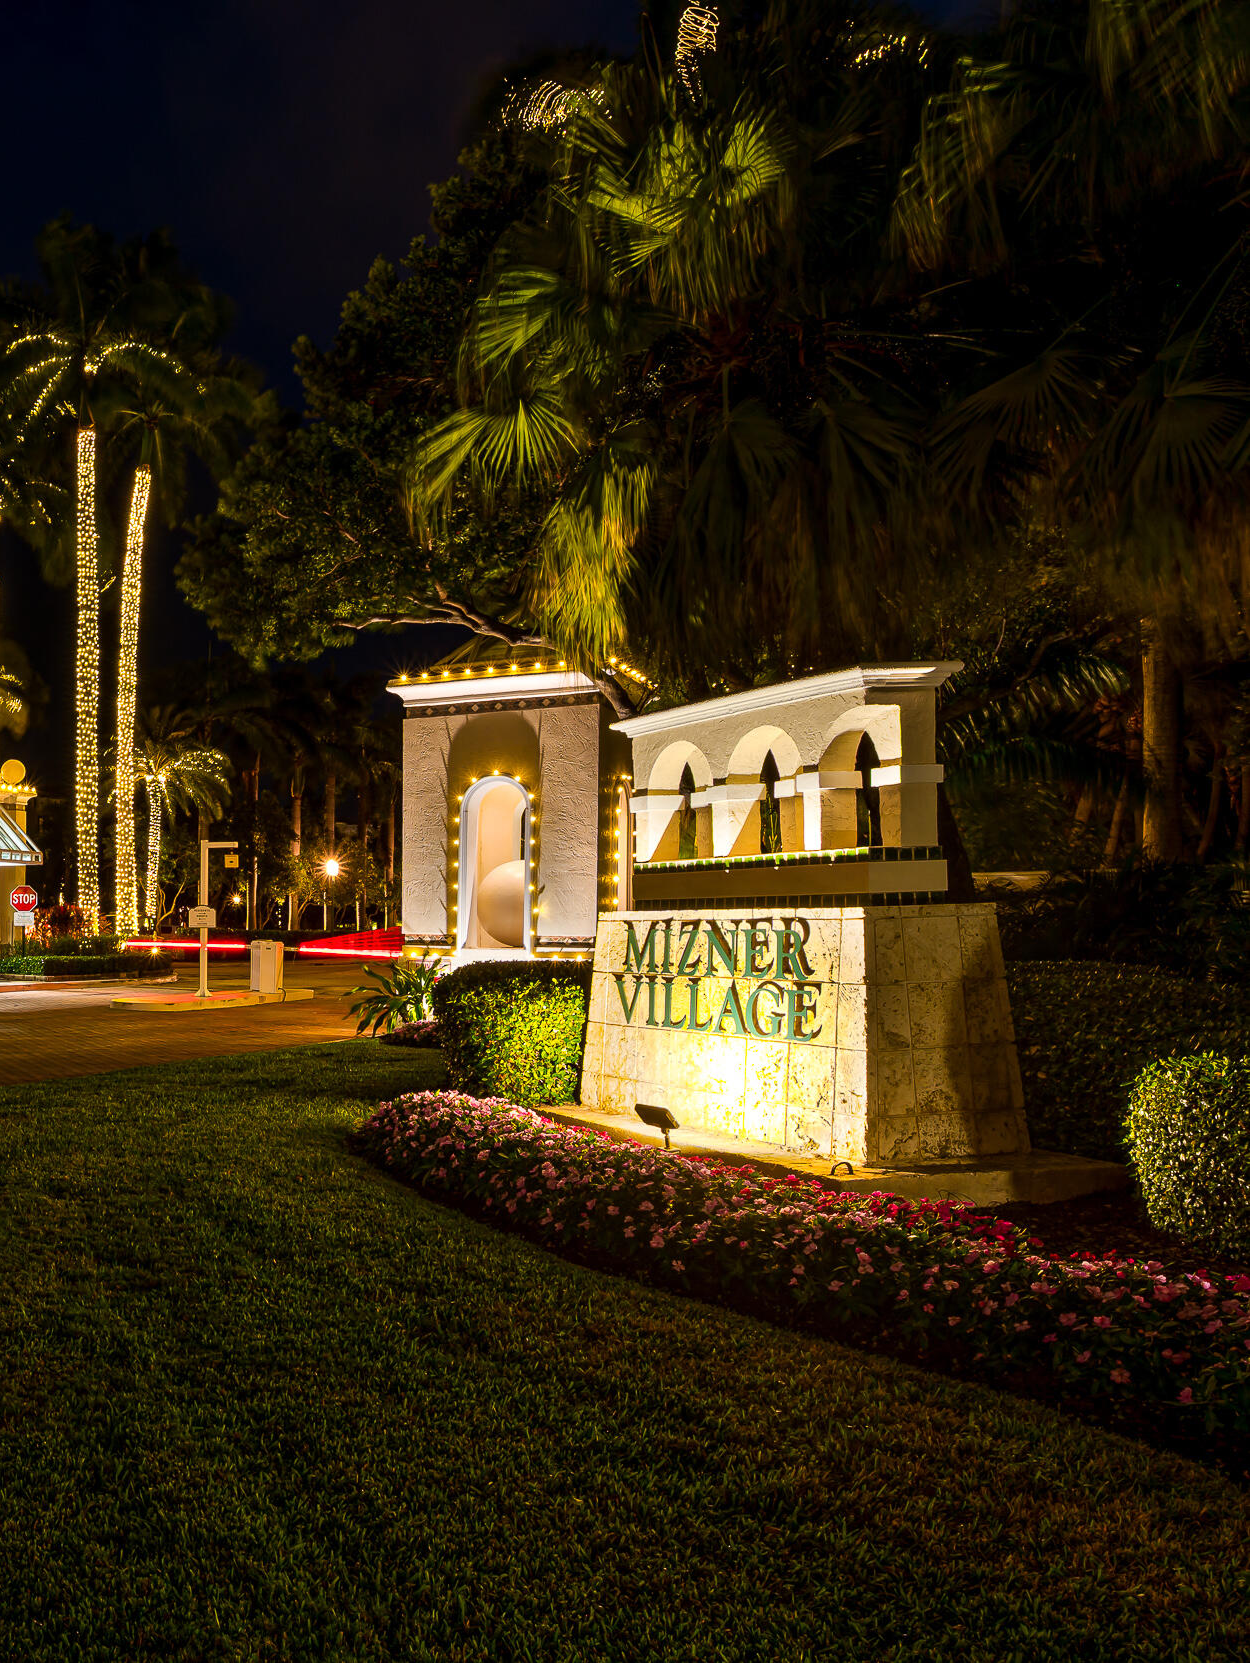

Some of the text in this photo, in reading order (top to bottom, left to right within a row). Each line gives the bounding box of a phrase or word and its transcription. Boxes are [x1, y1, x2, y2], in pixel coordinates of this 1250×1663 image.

[12, 893, 36, 904] STOP
[624, 928, 809, 981] MIZNER
[614, 980, 814, 1042] VILLAGE
